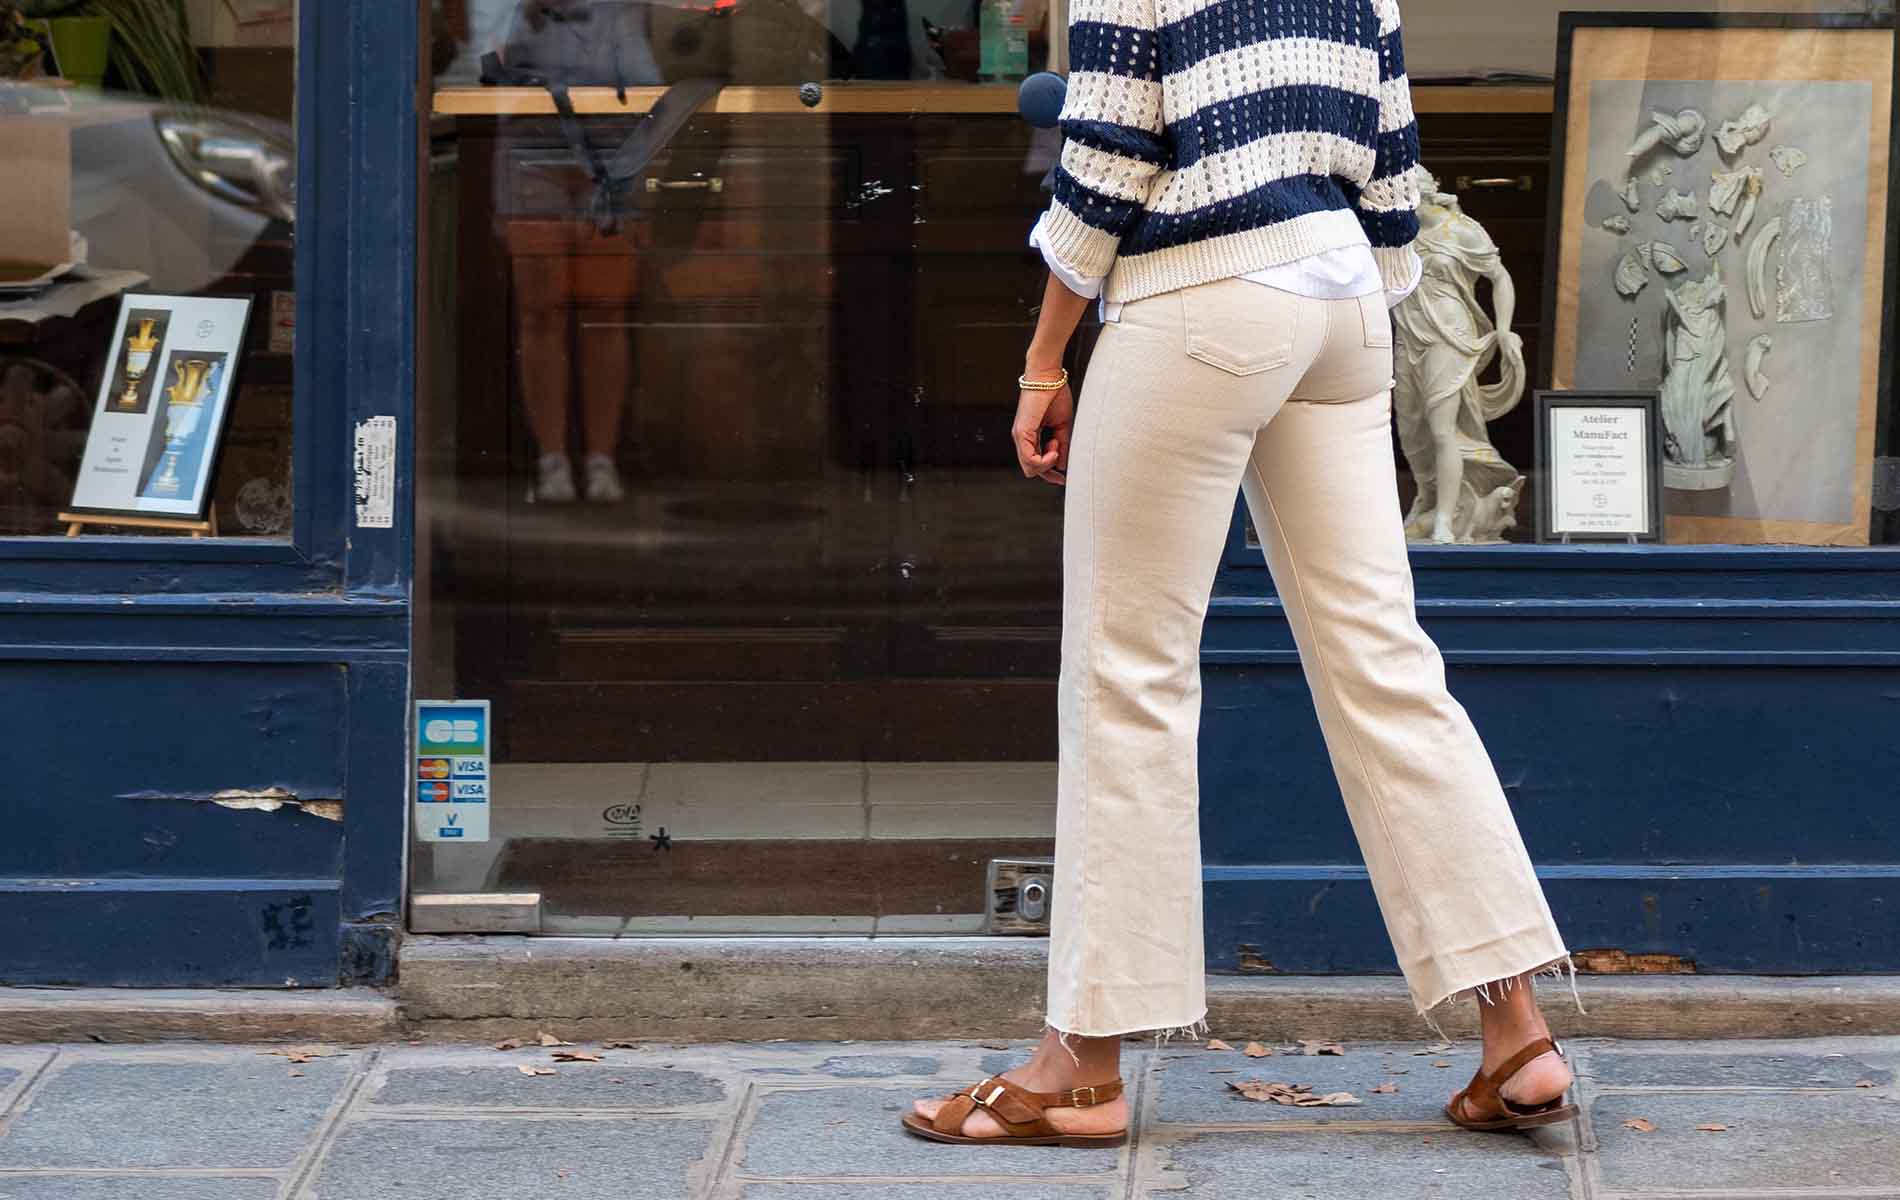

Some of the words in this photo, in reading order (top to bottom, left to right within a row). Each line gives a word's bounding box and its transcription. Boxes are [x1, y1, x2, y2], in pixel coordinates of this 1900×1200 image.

[1582, 414, 1619, 424] Atelier
[1573, 430, 1628, 440] ManuFact
[456, 761, 484, 772] VISA
[456, 784, 484, 795] VISA
